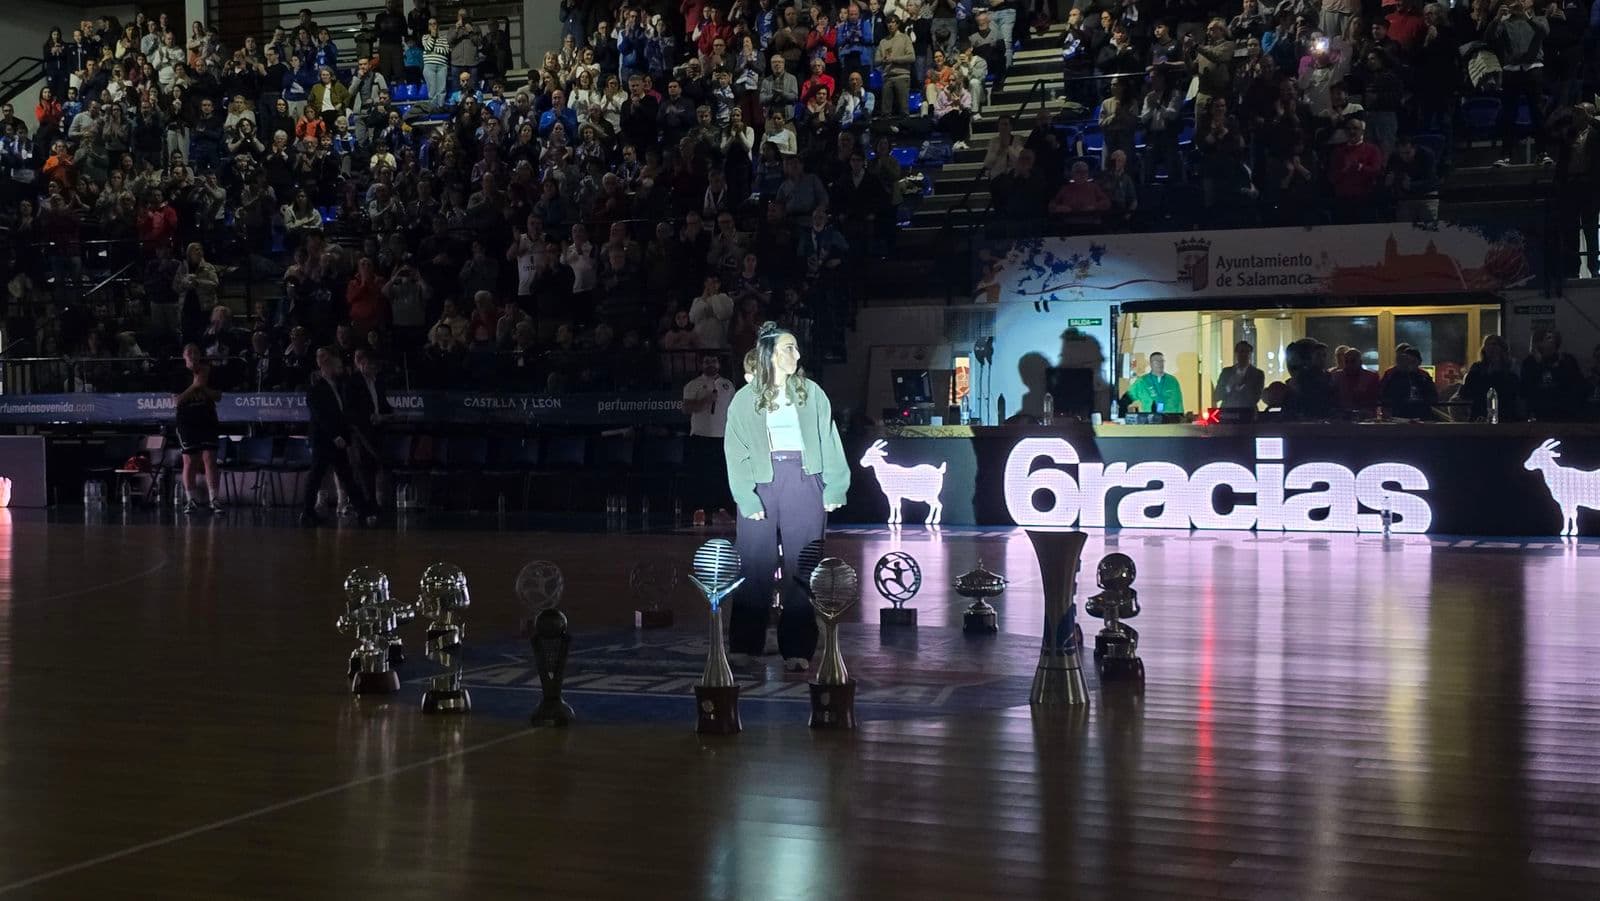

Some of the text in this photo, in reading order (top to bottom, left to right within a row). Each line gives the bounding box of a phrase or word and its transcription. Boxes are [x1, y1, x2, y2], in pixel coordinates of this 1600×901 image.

[1216, 252, 1313, 272] Ayuntamiento
[1216, 271, 1313, 287] de Salamanca
[235, 397, 282, 408] CASTILLA
[287, 396, 294, 408] Y
[464, 395, 562, 410] CASTILLA Y LEÓN
